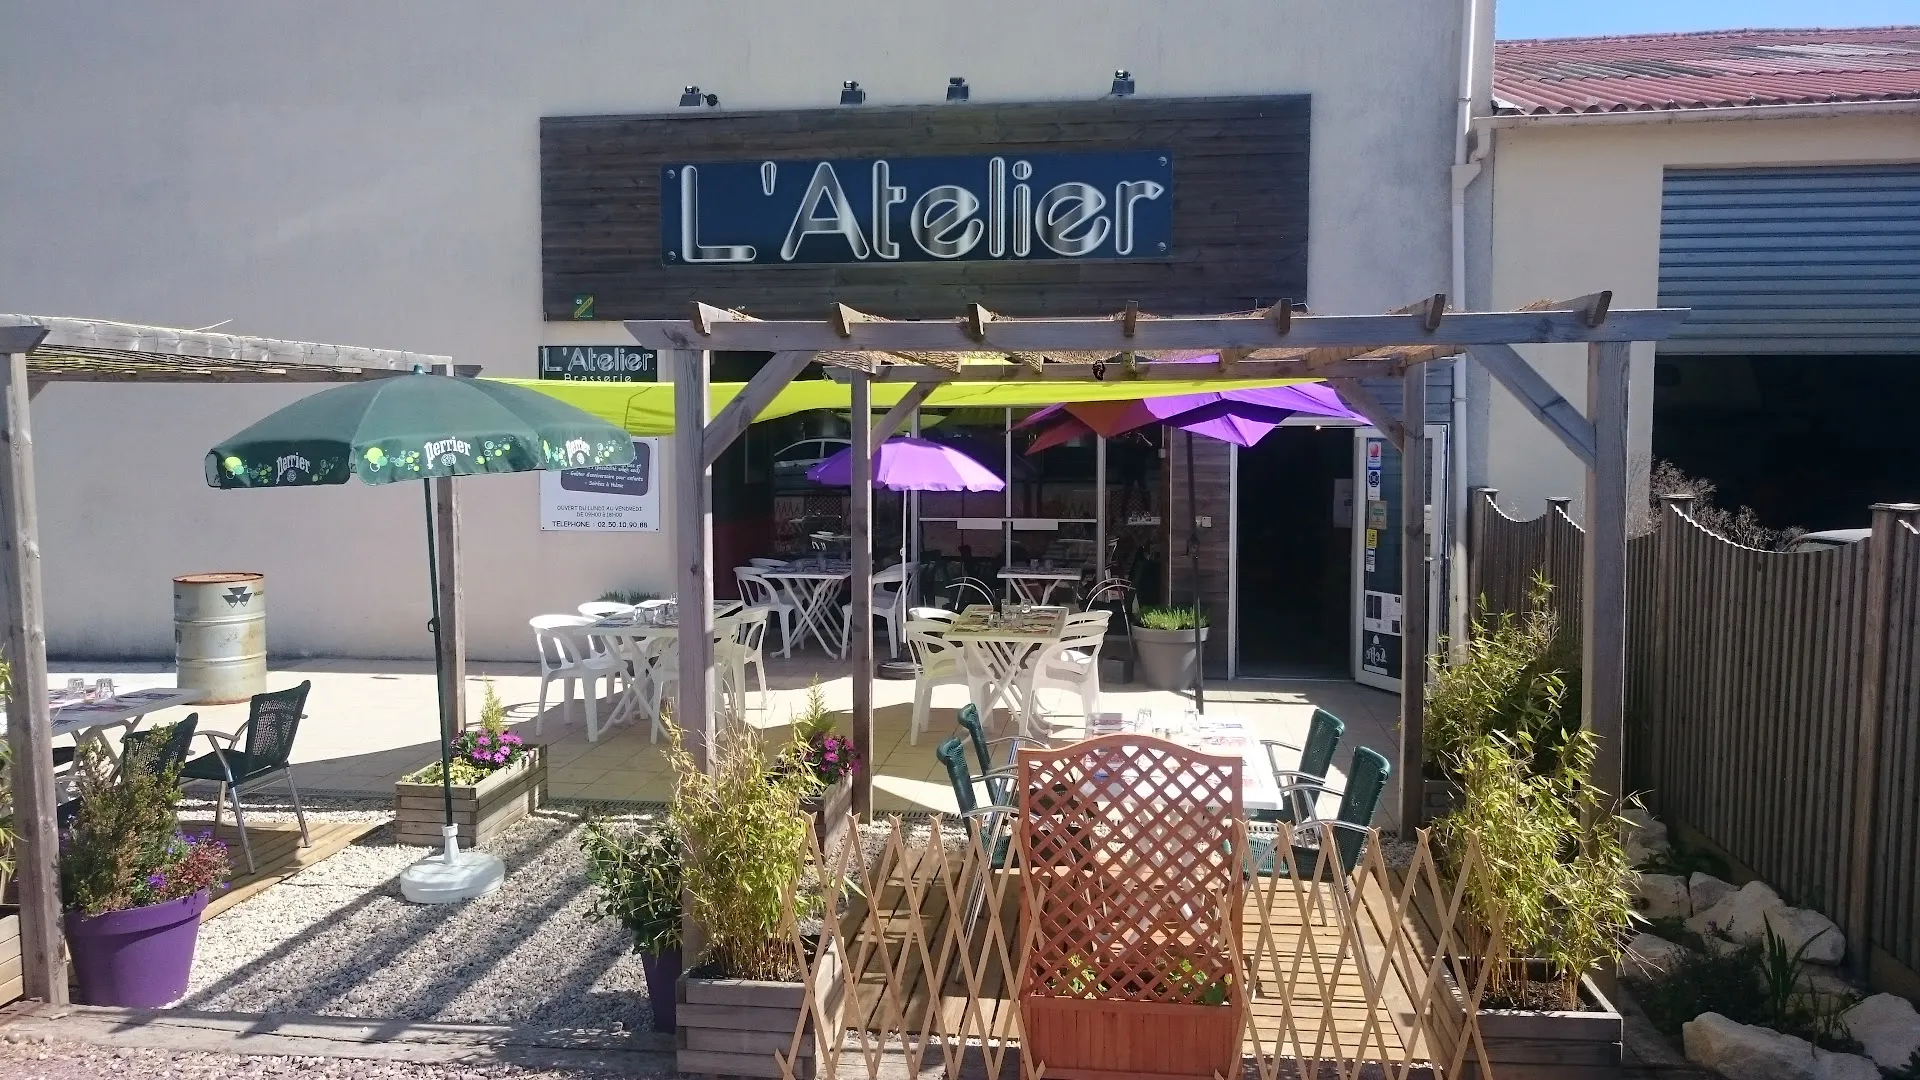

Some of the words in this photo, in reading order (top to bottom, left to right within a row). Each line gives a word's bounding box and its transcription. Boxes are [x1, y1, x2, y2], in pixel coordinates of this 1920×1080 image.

[681, 156, 1164, 263] L'Atelier
[544, 347, 654, 371] L'Atelier
[564, 373, 632, 382] Brasserie
